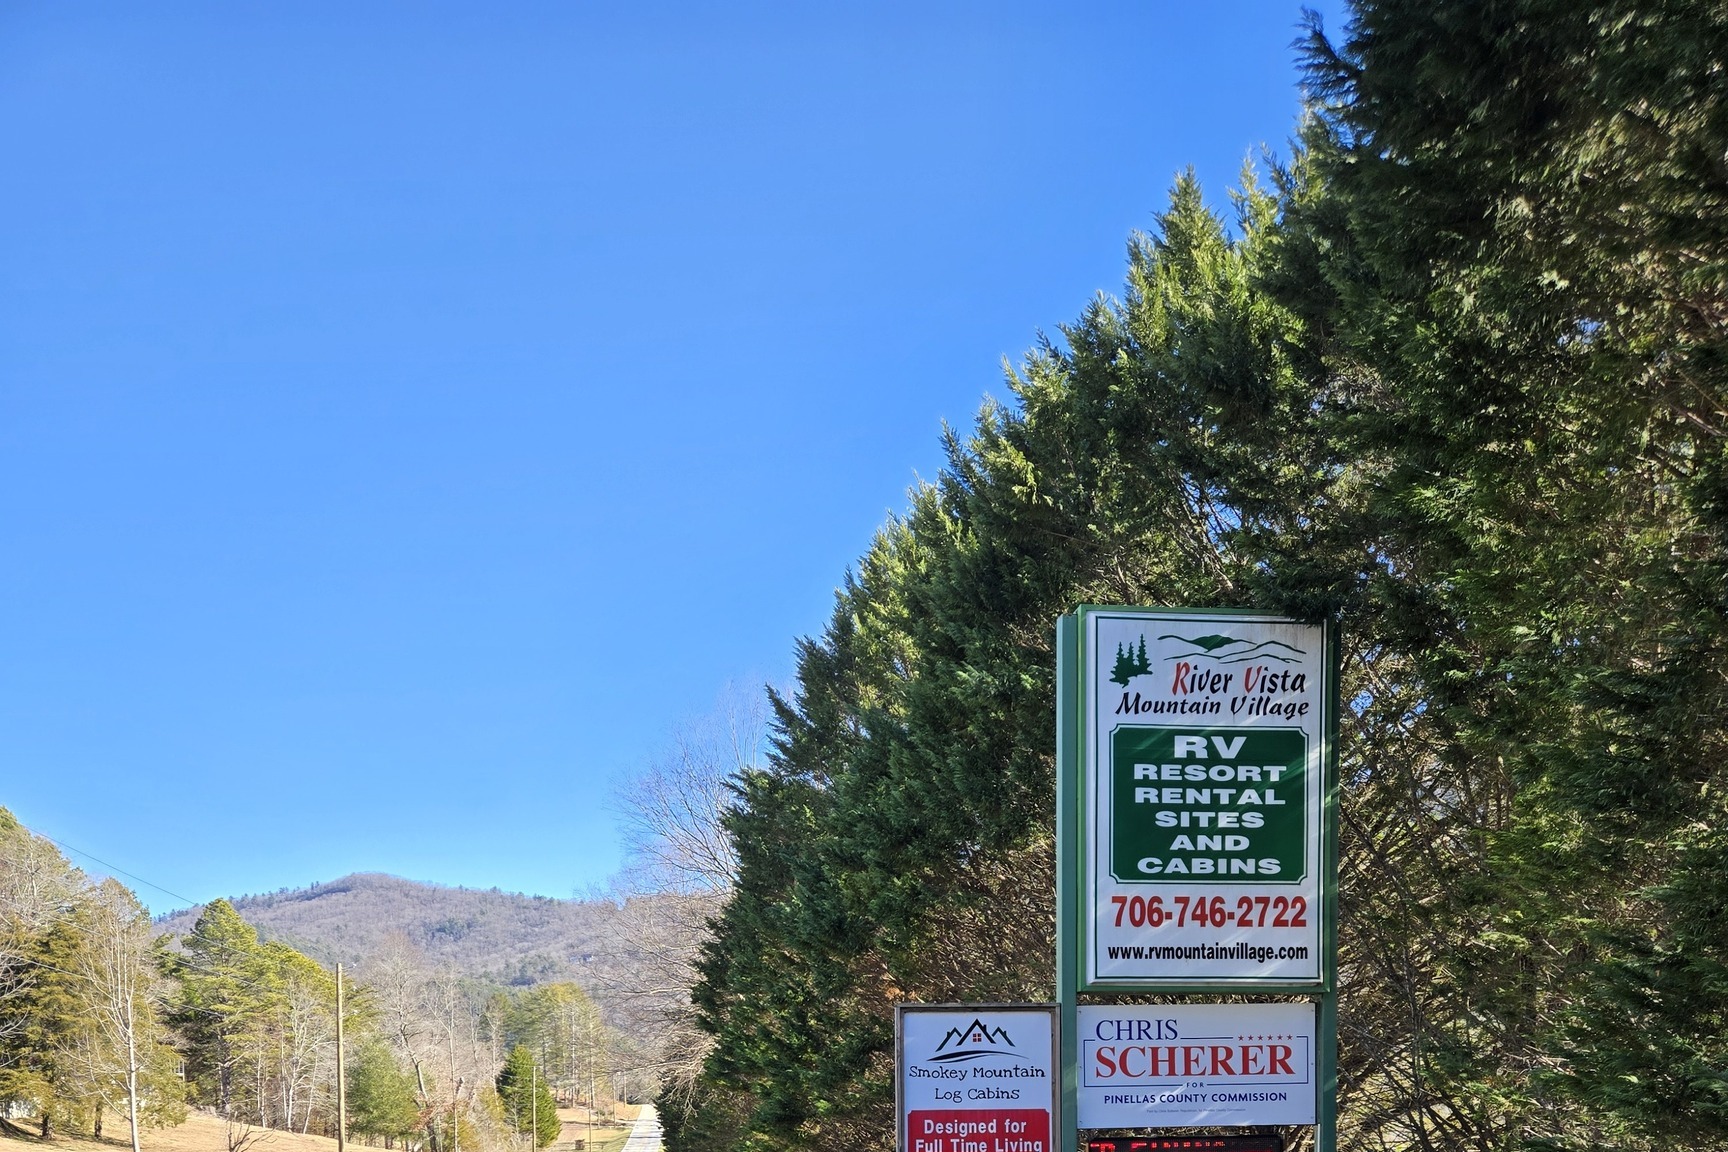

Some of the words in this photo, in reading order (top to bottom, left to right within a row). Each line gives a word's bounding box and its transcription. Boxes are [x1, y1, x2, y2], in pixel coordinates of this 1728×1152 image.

[1172, 661, 1232, 695] River
[1244, 665, 1306, 694] Vista
[1115, 691, 1221, 715] Mountain
[1231, 695, 1309, 721] Village
[1174, 735, 1247, 759] RV
[1133, 764, 1287, 782] RESORT
[1135, 787, 1286, 805] RENTAL
[1155, 811, 1265, 828] SITES
[1169, 835, 1250, 851] AND
[1137, 857, 1282, 875] CABINS
[1111, 896, 1307, 928] 706-746-2722
[1108, 942, 1308, 963] www.rvmountainvillage.com
[1096, 1019, 1178, 1041] CHRIS
[1096, 1044, 1296, 1079] SCHERER
[908, 1066, 968, 1081] Smokey
[972, 1064, 1046, 1078] Mountain
[934, 1088, 963, 1103] Log
[967, 1087, 1020, 1100] Cabins
[1104, 1094, 1156, 1104] PINELLAS
[1159, 1093, 1208, 1103] COUNTY
[1211, 1092, 1287, 1102] COMMISSION
[924, 1119, 997, 1137] Designed
[1004, 1119, 1027, 1134] for
[950, 1138, 988, 1152] Time
